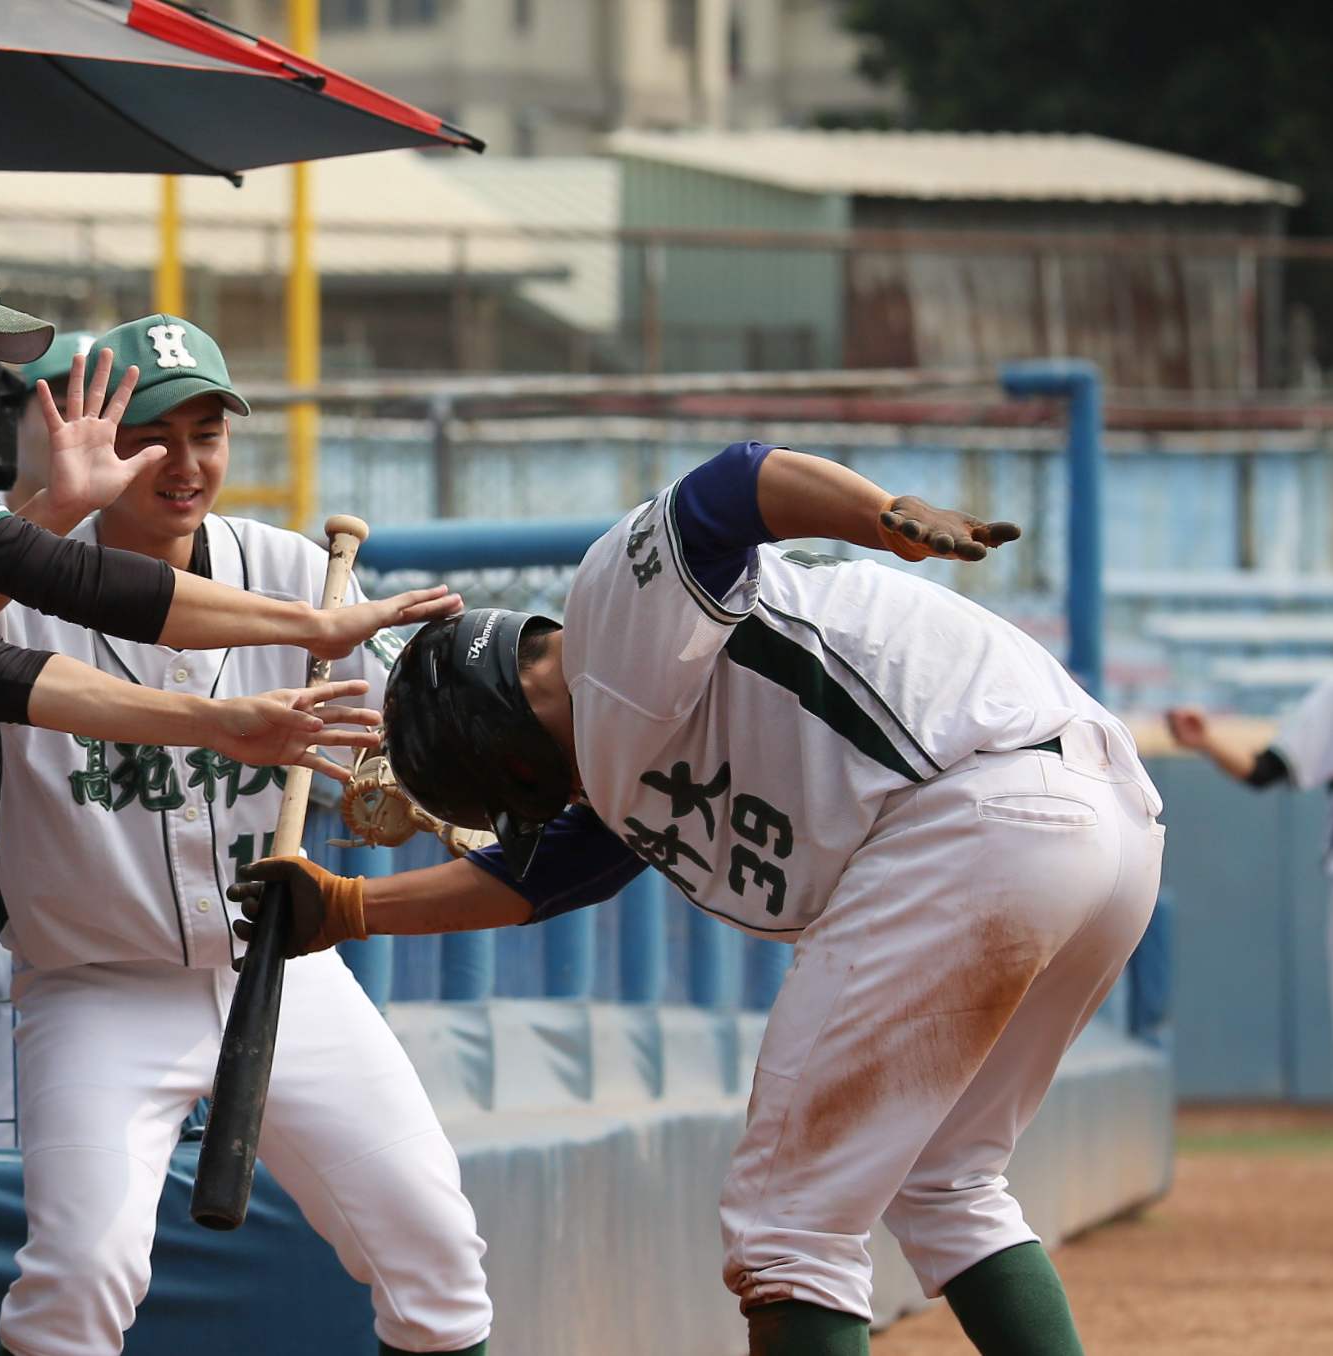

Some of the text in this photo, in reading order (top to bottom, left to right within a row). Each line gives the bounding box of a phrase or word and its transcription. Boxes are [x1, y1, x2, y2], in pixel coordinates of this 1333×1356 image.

[148, 325, 198, 368] H
[228, 831, 276, 882] 1
[728, 793, 794, 917] 39
